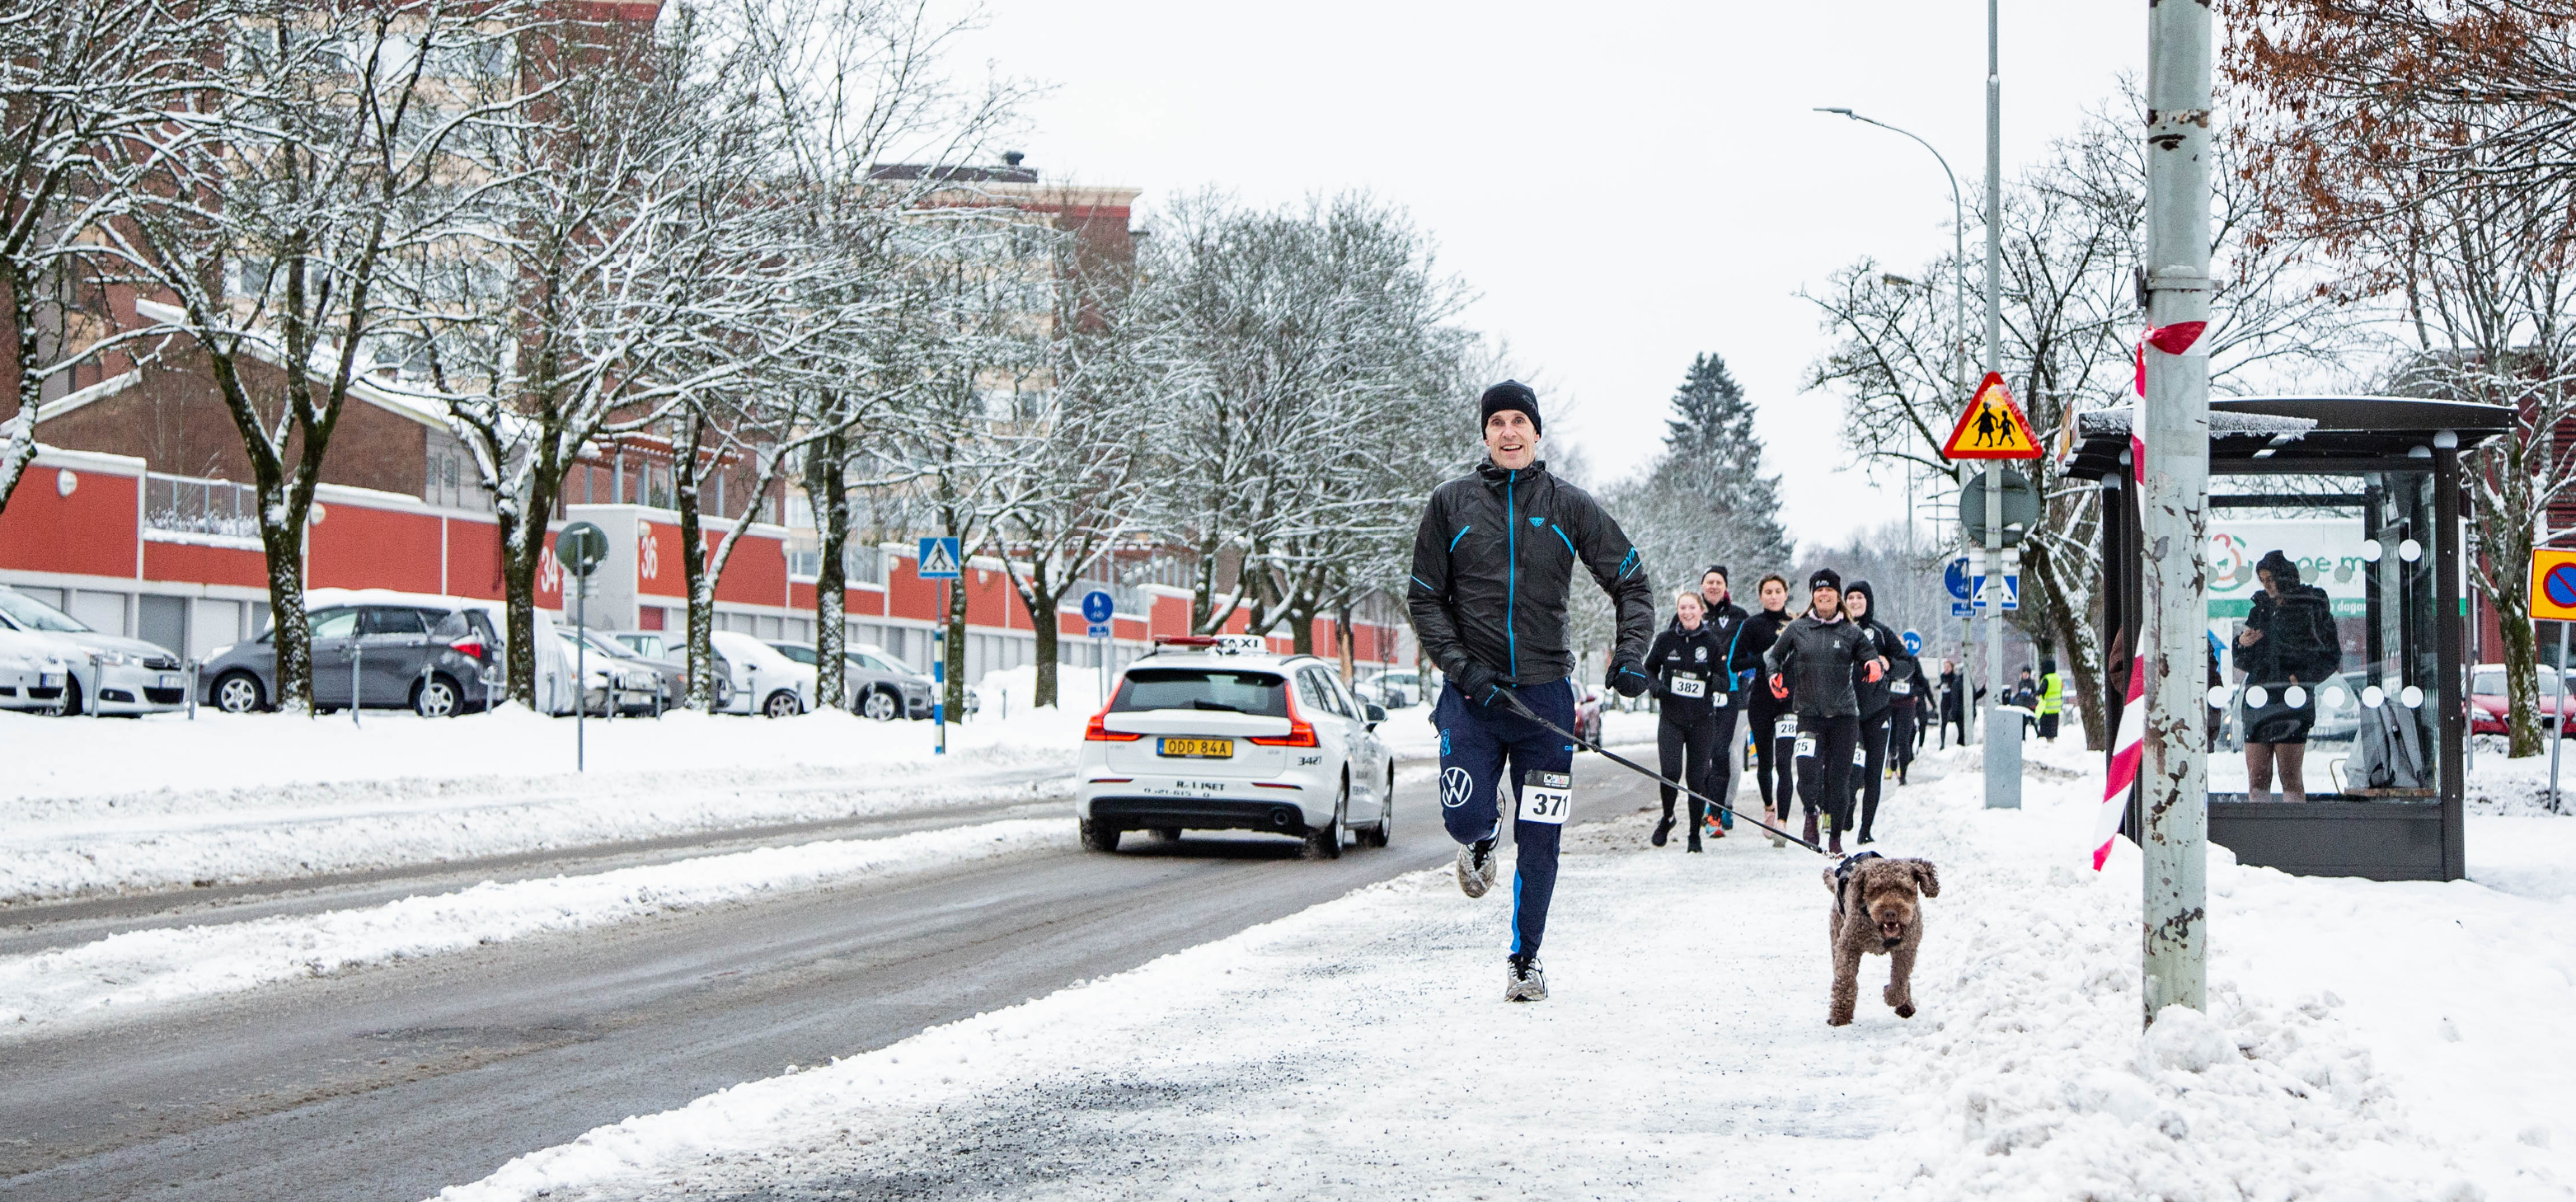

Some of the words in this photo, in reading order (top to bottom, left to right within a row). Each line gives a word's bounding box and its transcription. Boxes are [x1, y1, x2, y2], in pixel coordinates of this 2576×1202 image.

[641, 536, 658, 580] 36
[541, 546, 559, 592] 34
[1677, 681, 1699, 694] 382
[1168, 740, 1194, 754] ODD
[1200, 741, 1227, 755] 84A
[1297, 755, 1322, 766] 3427
[1532, 793, 1569, 816] 371
